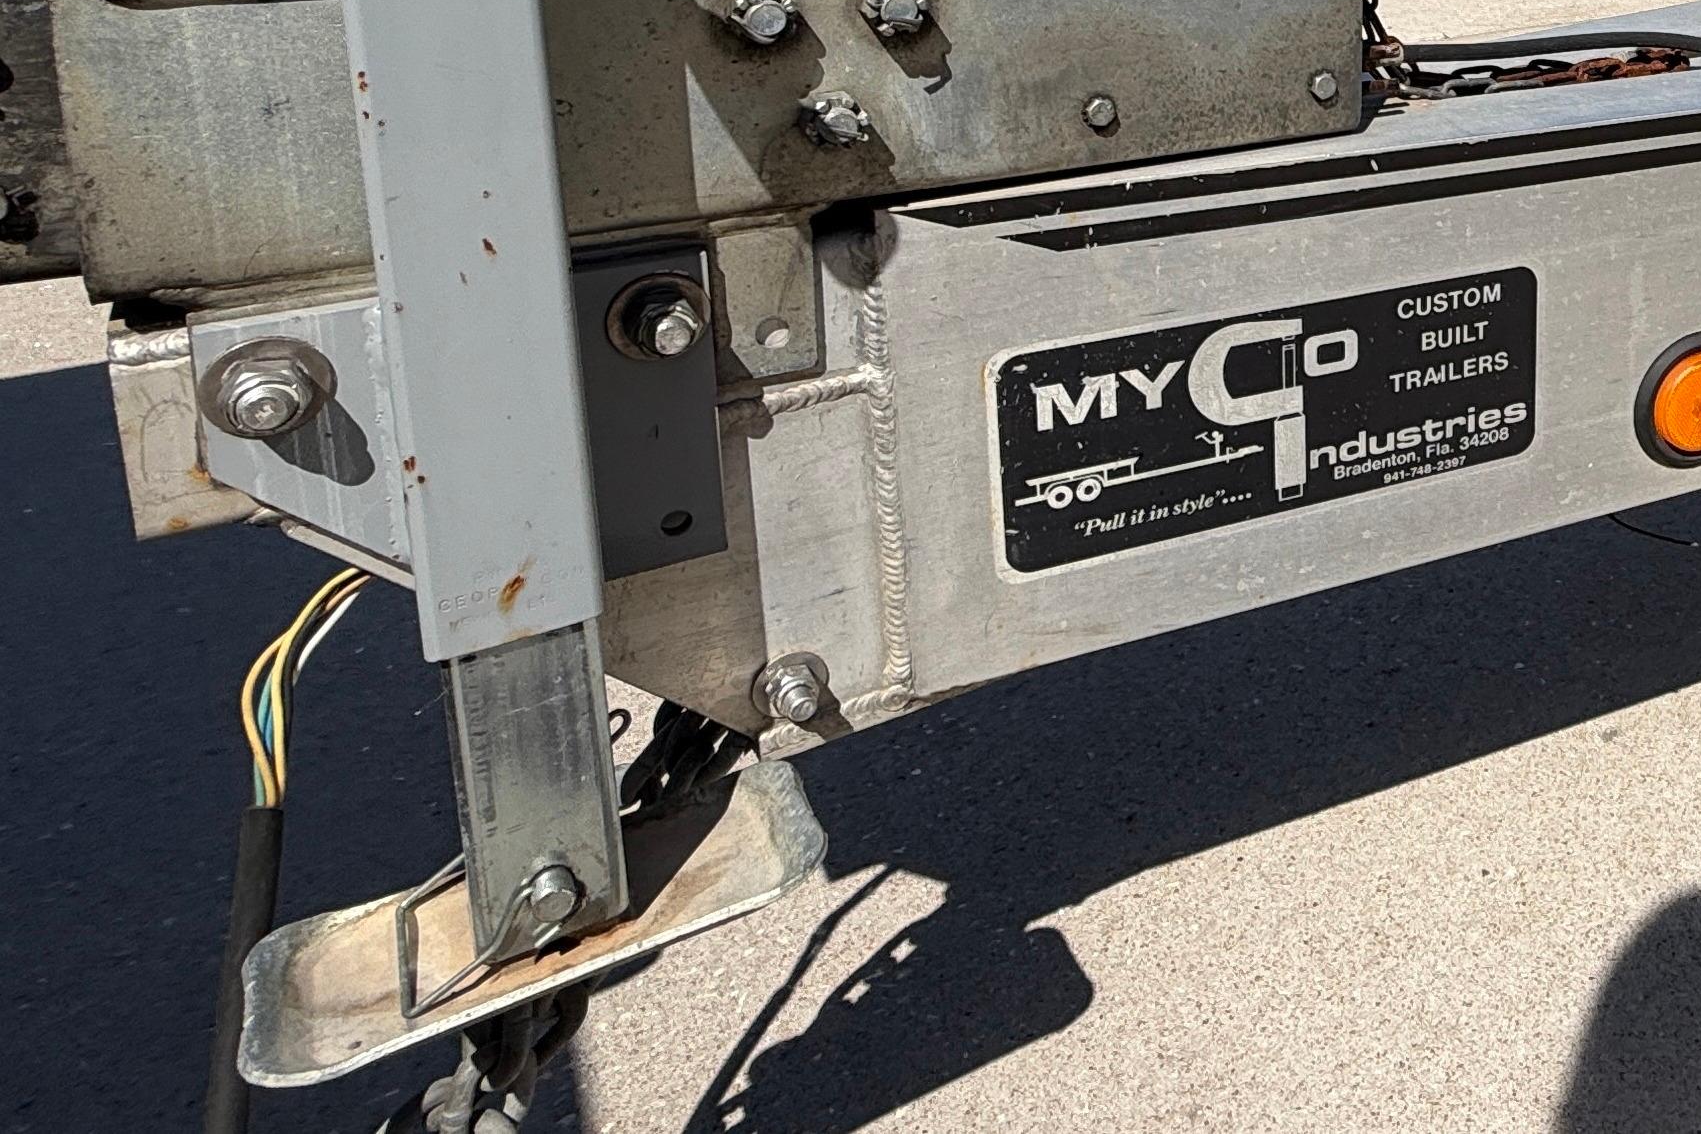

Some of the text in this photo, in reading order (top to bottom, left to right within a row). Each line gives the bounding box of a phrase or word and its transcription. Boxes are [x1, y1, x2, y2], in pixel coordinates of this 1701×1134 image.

[1397, 284, 1501, 319] CUSTOM
[1421, 320, 1489, 352] BUILT
[1389, 352, 1509, 393] TRAILERS
[1333, 428, 1510, 480] Bradenton, Fla. 34208
[1383, 455, 1467, 484] 941-748-2397
[1130, 509, 1145, 526] it
[1148, 504, 1169, 521] in
